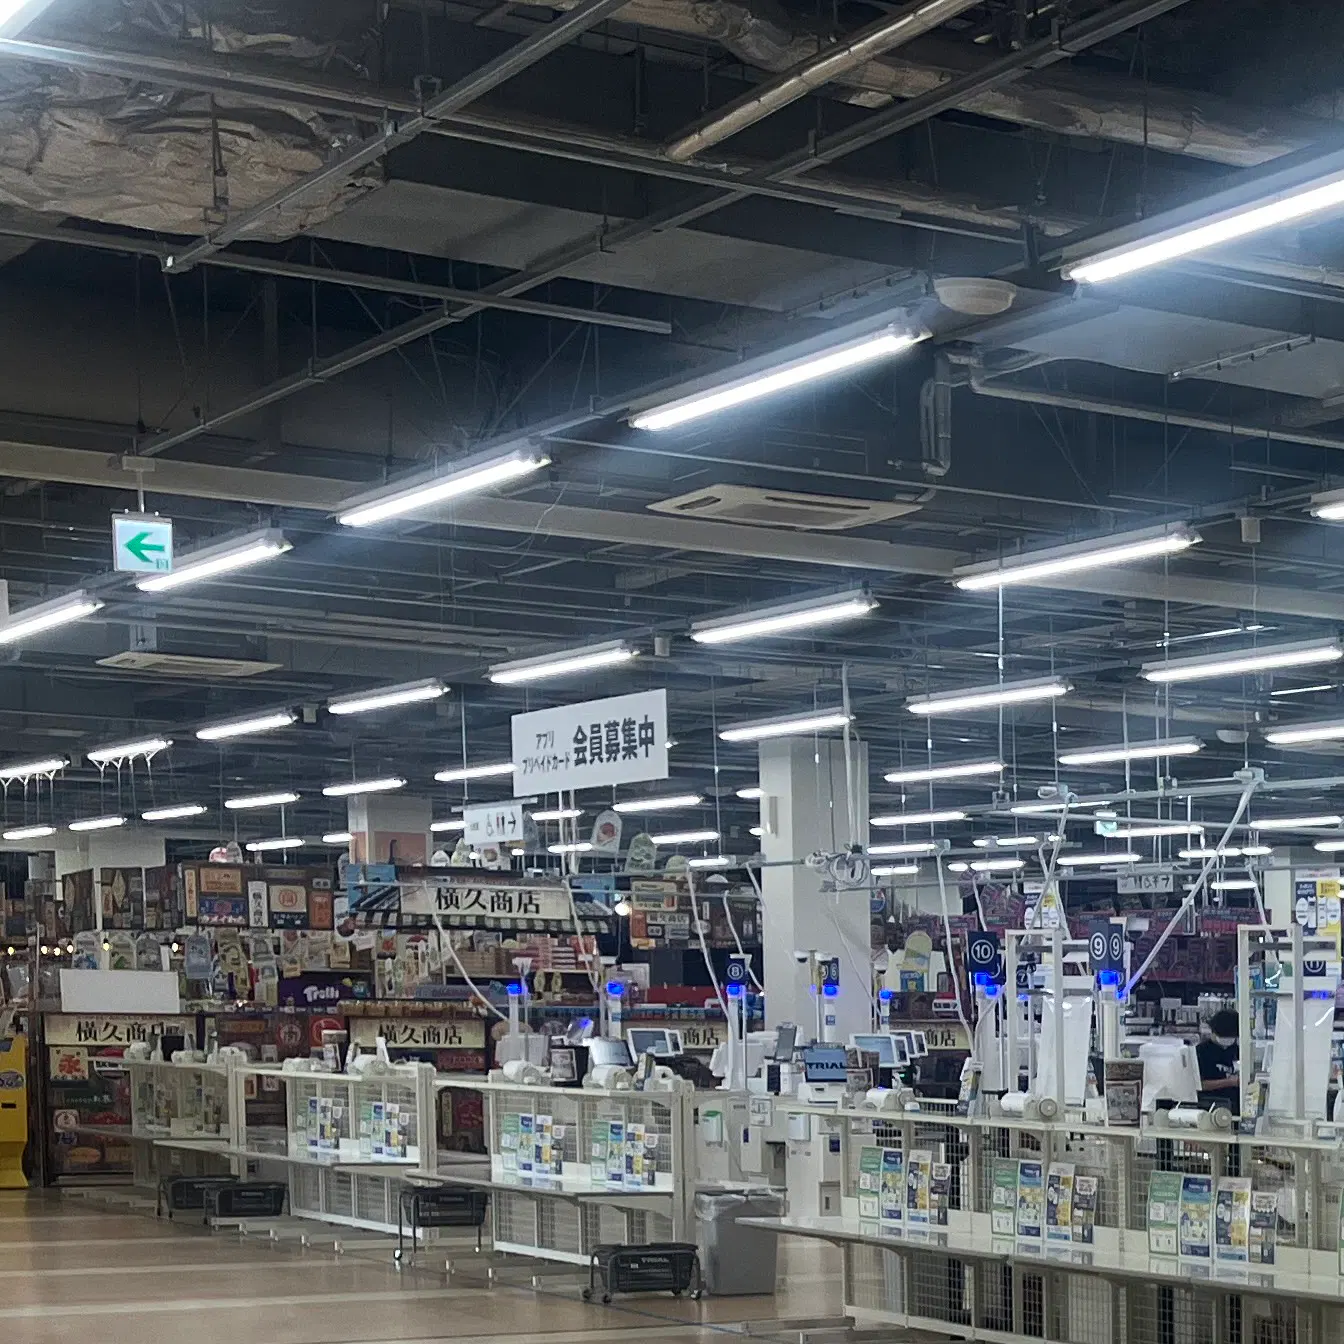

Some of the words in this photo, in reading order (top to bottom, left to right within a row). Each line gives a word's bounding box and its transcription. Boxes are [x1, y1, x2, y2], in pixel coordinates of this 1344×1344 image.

[535, 730, 555, 750] アプリ
[572, 714, 655, 767] 会員募集中
[522, 752, 571, 775] プリペイドカード
[435, 886, 542, 915] 横久商店
[76, 1019, 165, 1043] 横久商
[379, 1023, 463, 1046] 横久商店
[683, 1027, 720, 1048] 商店
[807, 1061, 846, 1071] TRIAL
